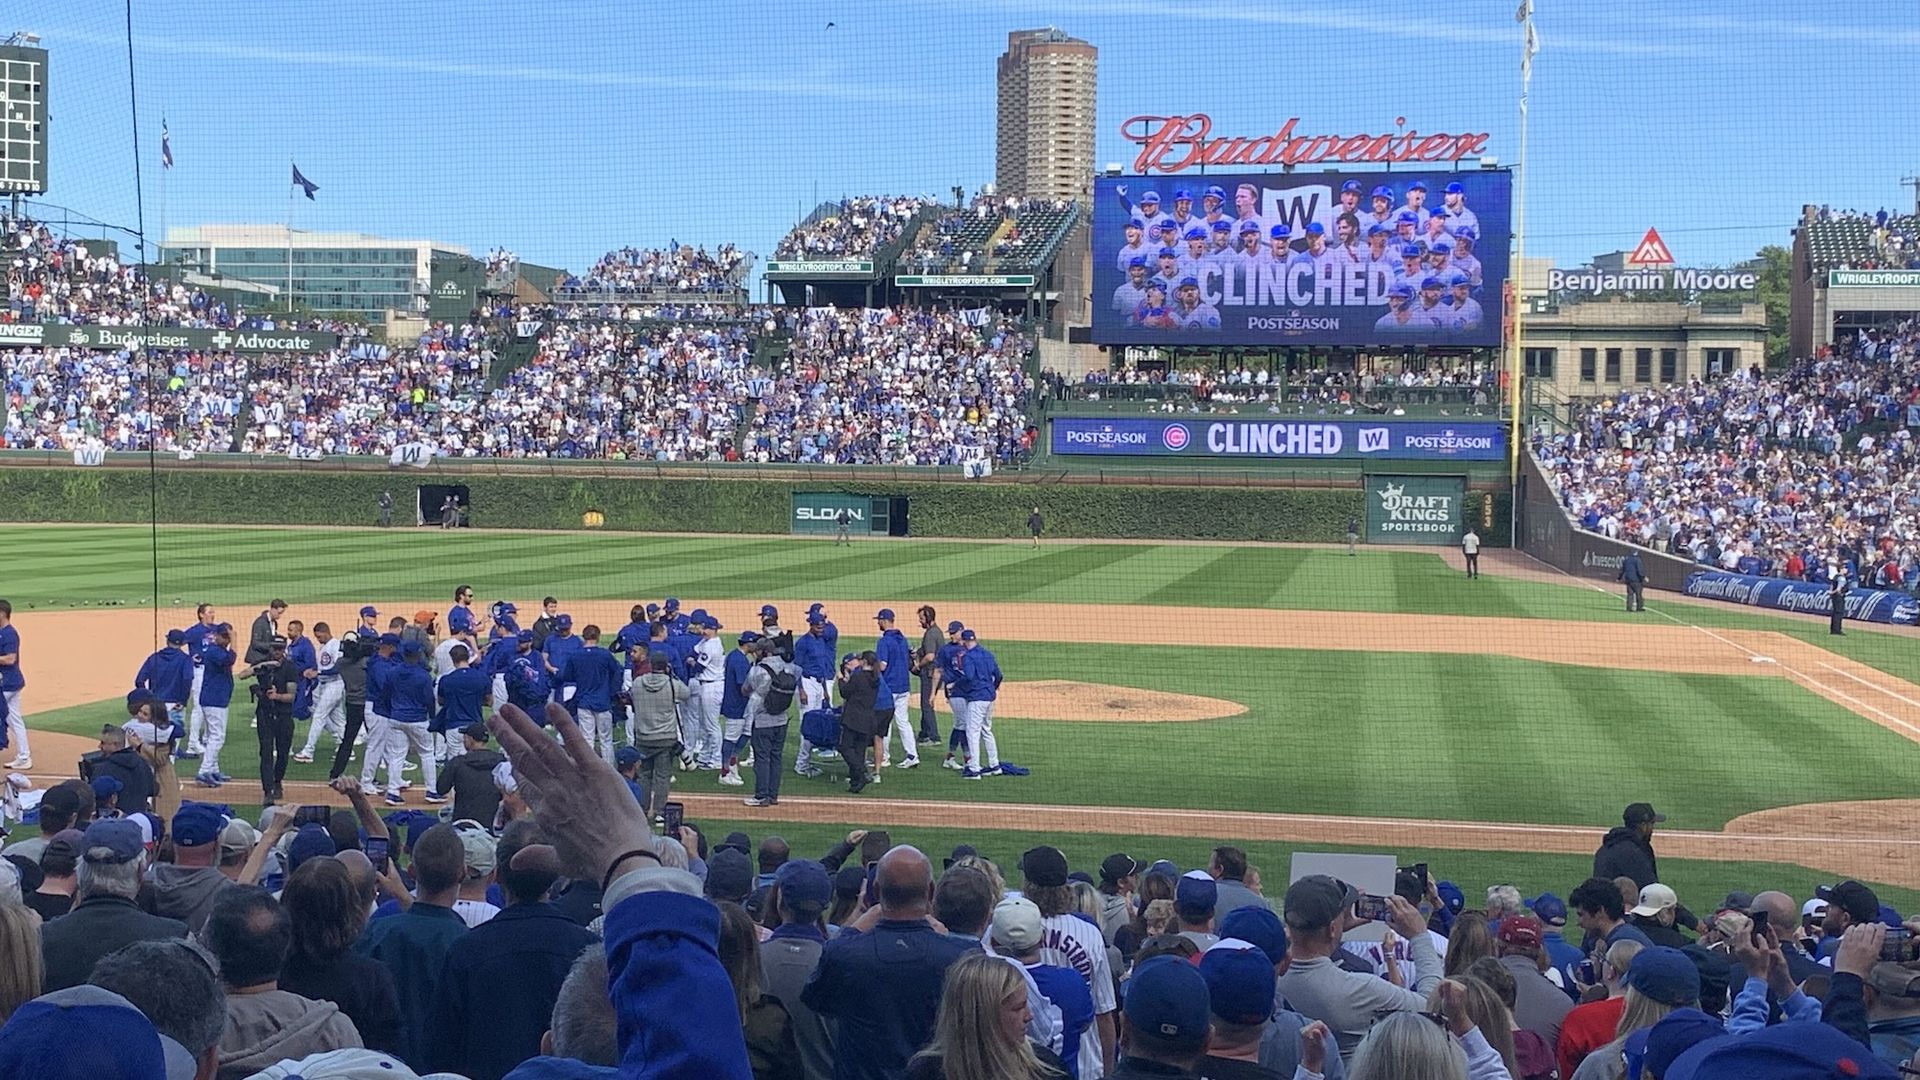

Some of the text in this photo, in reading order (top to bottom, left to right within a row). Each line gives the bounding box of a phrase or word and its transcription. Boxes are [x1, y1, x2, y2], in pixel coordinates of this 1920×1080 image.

[1121, 113, 1489, 173] Budweiser
[1276, 193, 1320, 230] W
[778, 262, 861, 272] WRIGLEYROOFTOPS.COM
[1200, 263, 1391, 306] CLINCHED
[1549, 269, 1755, 295] Benjamin Moore
[1837, 273, 1920, 284] WRIGLEYROOFT
[816, 310, 830, 320] W
[869, 310, 884, 324] W
[964, 310, 982, 325] W
[523, 323, 537, 335] W
[1248, 317, 1340, 330] POSTSEASON
[99, 330, 187, 346] Budweiser
[235, 333, 310, 349] Advocate
[364, 343, 382, 360] W
[207, 401, 226, 415] W
[1066, 431, 1146, 444] POSTSEASON
[1207, 423, 1343, 454] CLINCHED
[1365, 431, 1383, 449] W
[1405, 435, 1491, 449] POSTSEASON
[81, 449, 99, 464] W
[402, 446, 421, 462] W
[971, 461, 986, 478] W
[1382, 495, 1451, 511] DRAFT
[1484, 494, 1492, 528] 353
[1390, 507, 1449, 521] KINGS
[1381, 522, 1455, 533] SPORTSBOOK
[1777, 584, 1830, 611] Reynolds
